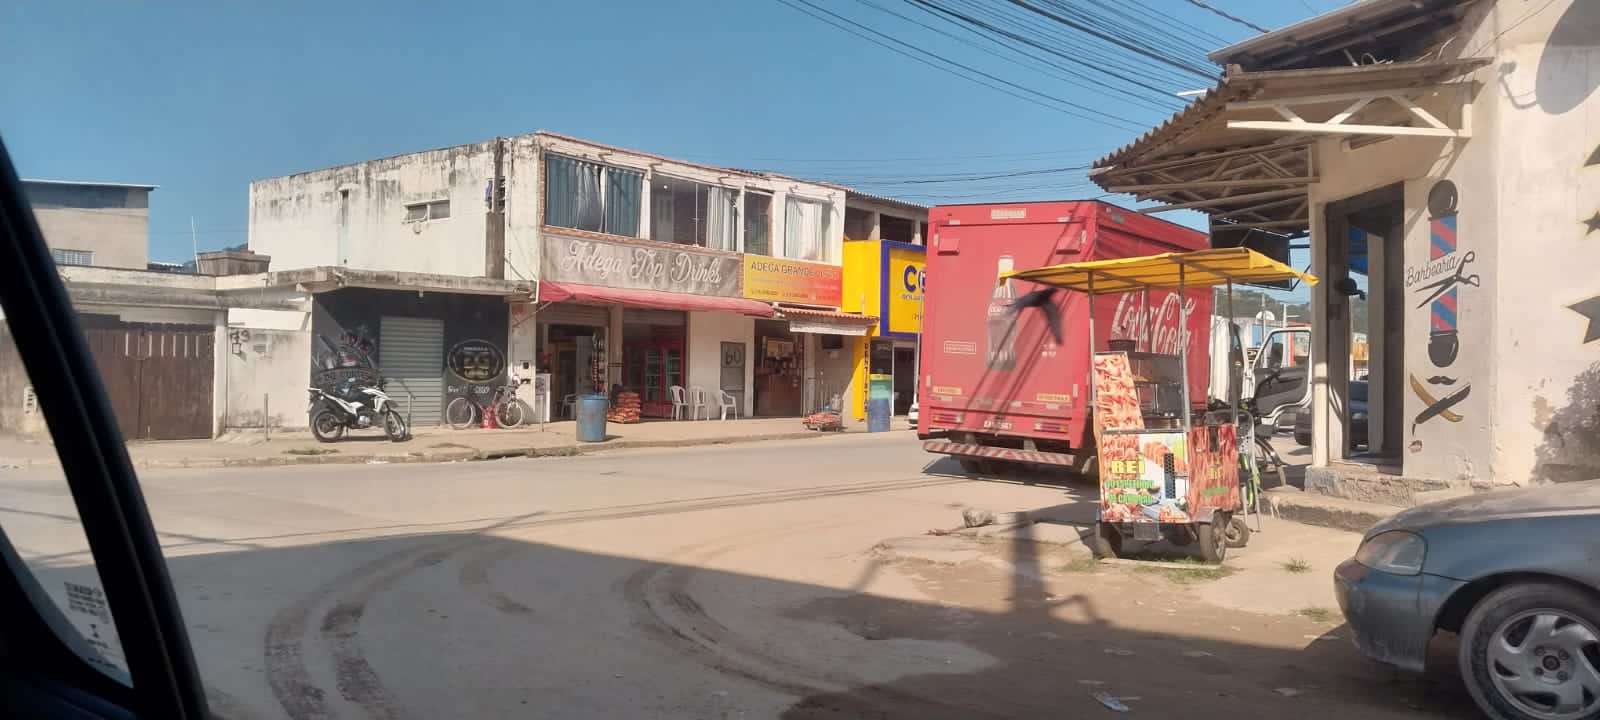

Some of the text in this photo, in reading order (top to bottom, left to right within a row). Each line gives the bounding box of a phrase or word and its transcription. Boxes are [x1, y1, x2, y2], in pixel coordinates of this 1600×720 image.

[561, 239, 722, 284] Adega Top Drinks
[751, 261, 780, 273] ADEGA
[781, 264, 813, 277] GRANDE
[1406, 256, 1461, 287] Barbearia
